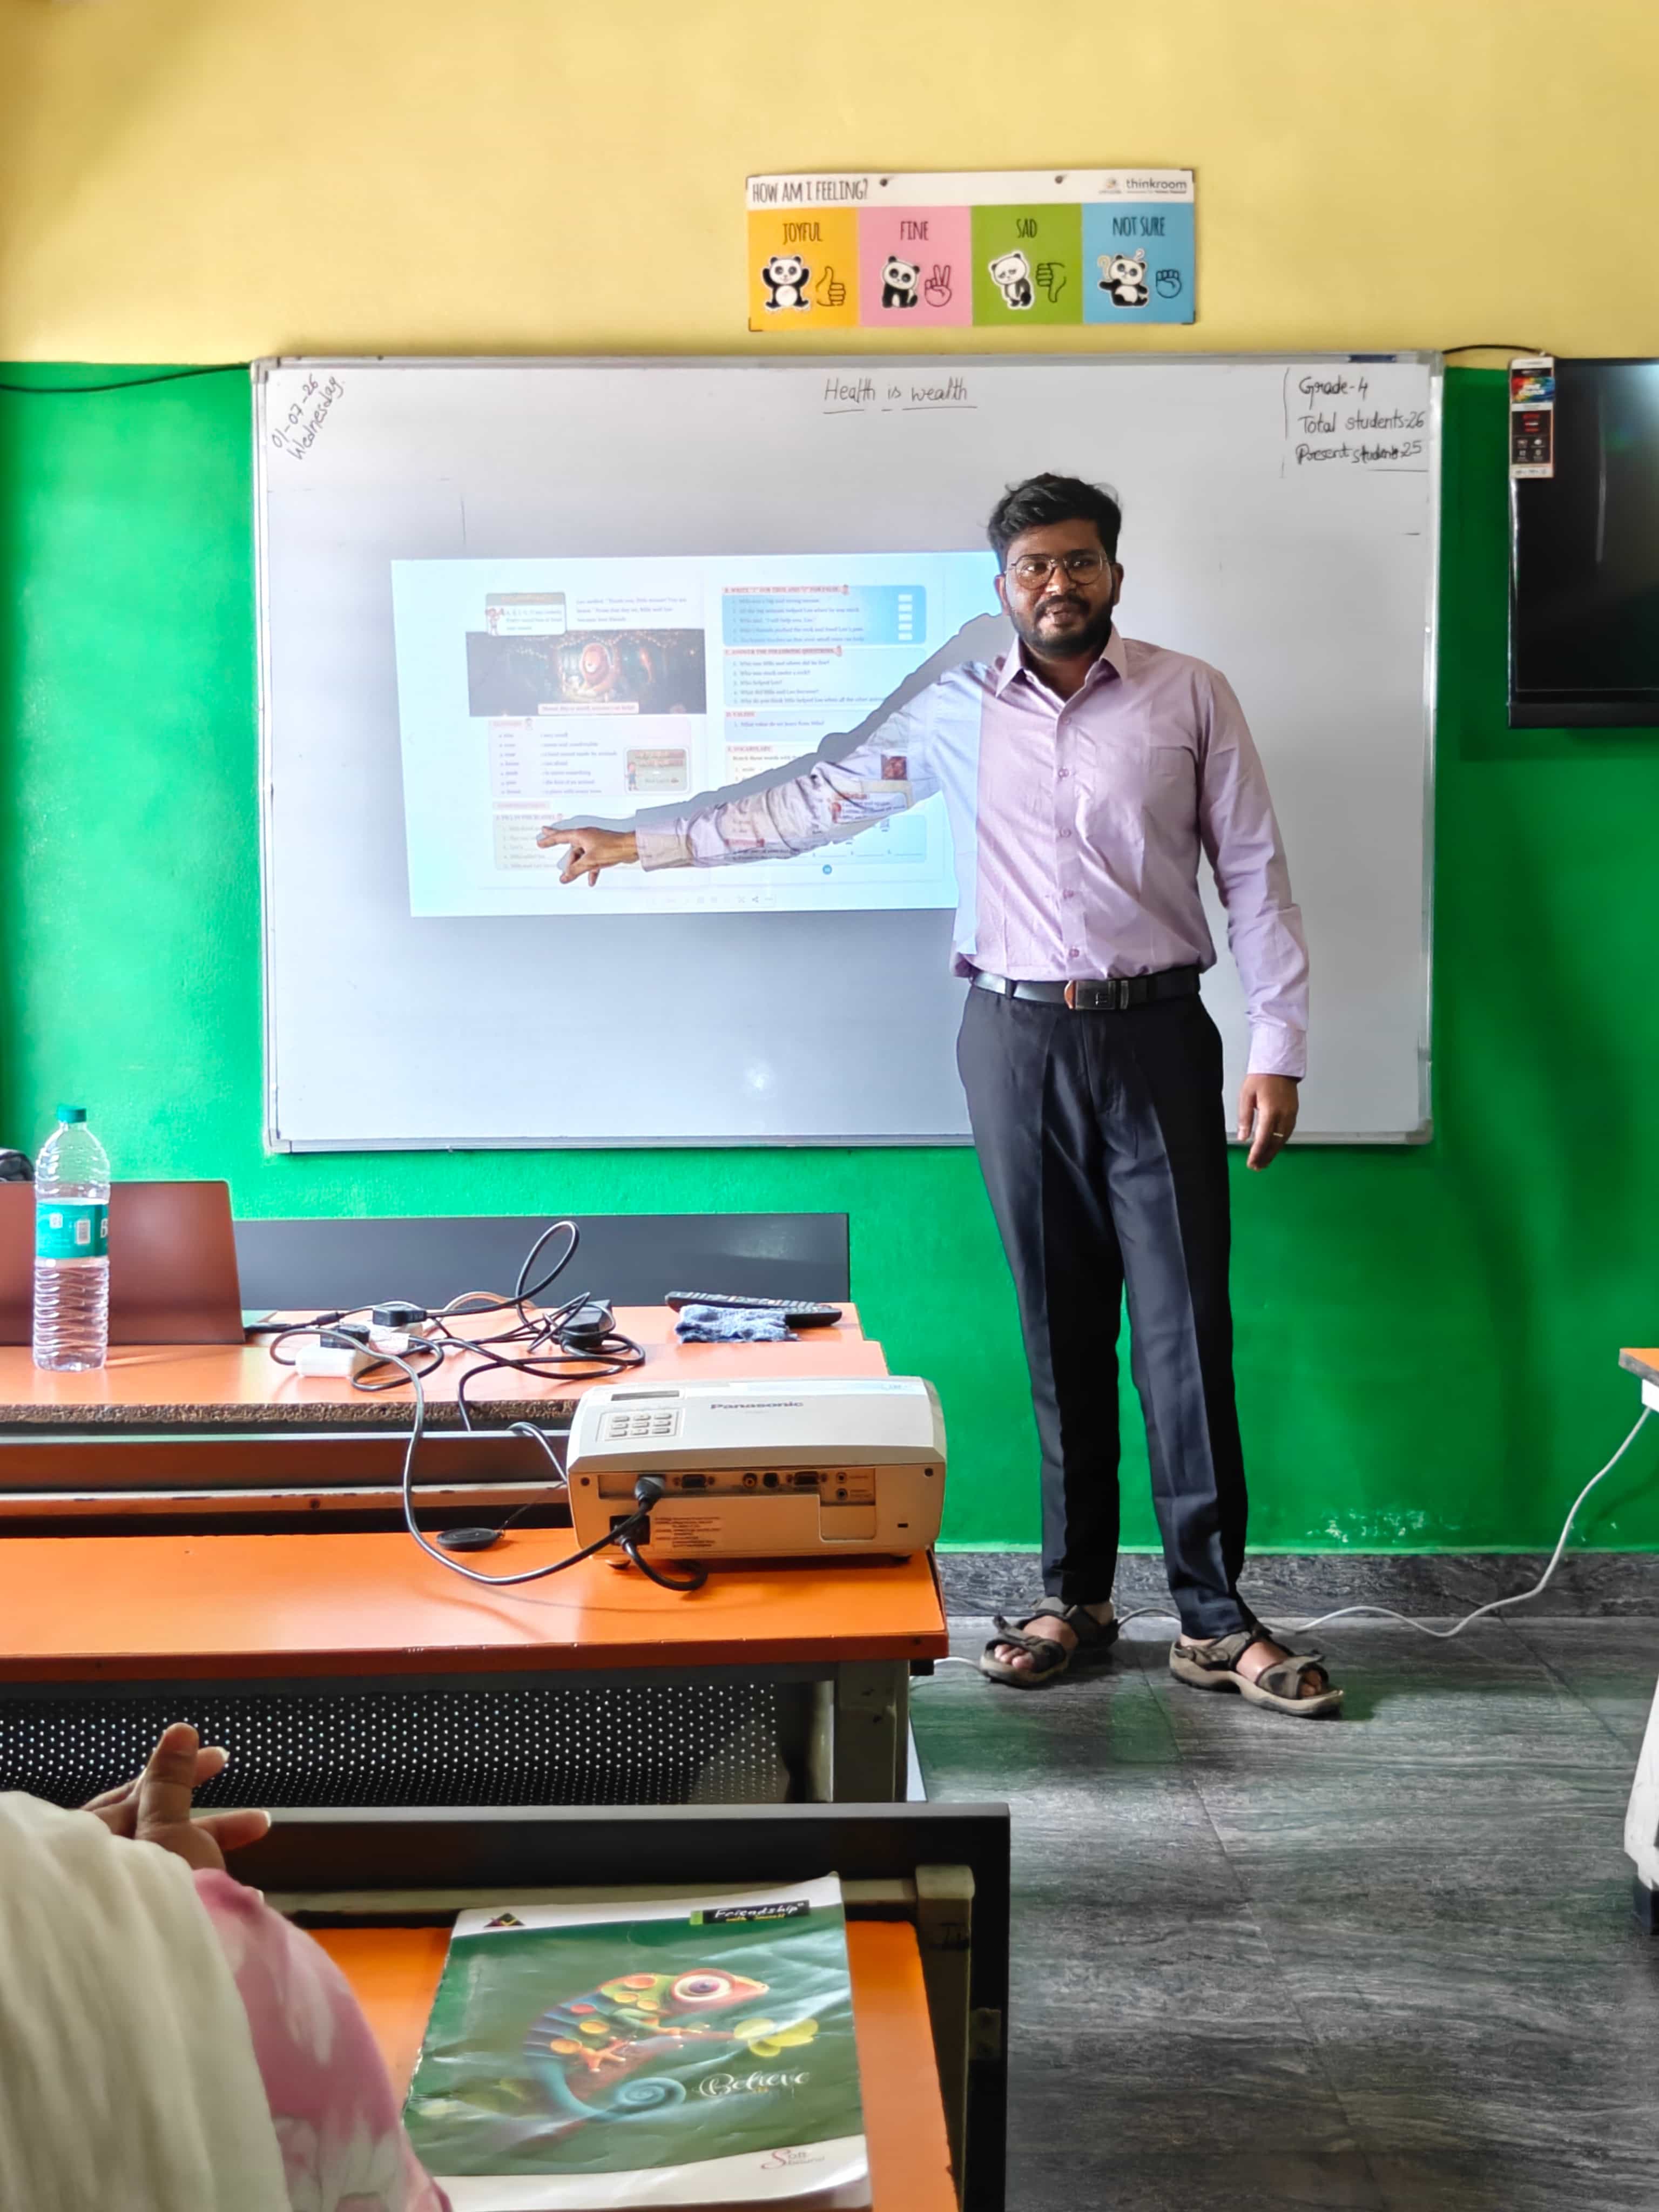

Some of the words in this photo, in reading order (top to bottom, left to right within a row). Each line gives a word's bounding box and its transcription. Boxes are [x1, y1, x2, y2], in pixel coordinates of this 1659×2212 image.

[752, 183, 778, 203] HOW
[782, 181, 802, 202] AM
[807, 180, 812, 201] I
[816, 178, 868, 200] FEELING?
[1126, 177, 1187, 189] thinkroom
[783, 221, 822, 245] JOYFUL
[900, 221, 929, 241] FINE
[1016, 218, 1037, 238] SAD
[1112, 216, 1137, 236] NOT
[1140, 216, 1165, 237] SURE
[825, 377, 875, 403] Health
[888, 385, 901, 399] is
[912, 376, 968, 402] wealth
[1297, 412, 1337, 434] Total
[1296, 442, 1351, 465] Present
[711, 1401, 804, 1410] Panasonic
[714, 1904, 798, 1919] Friendship
